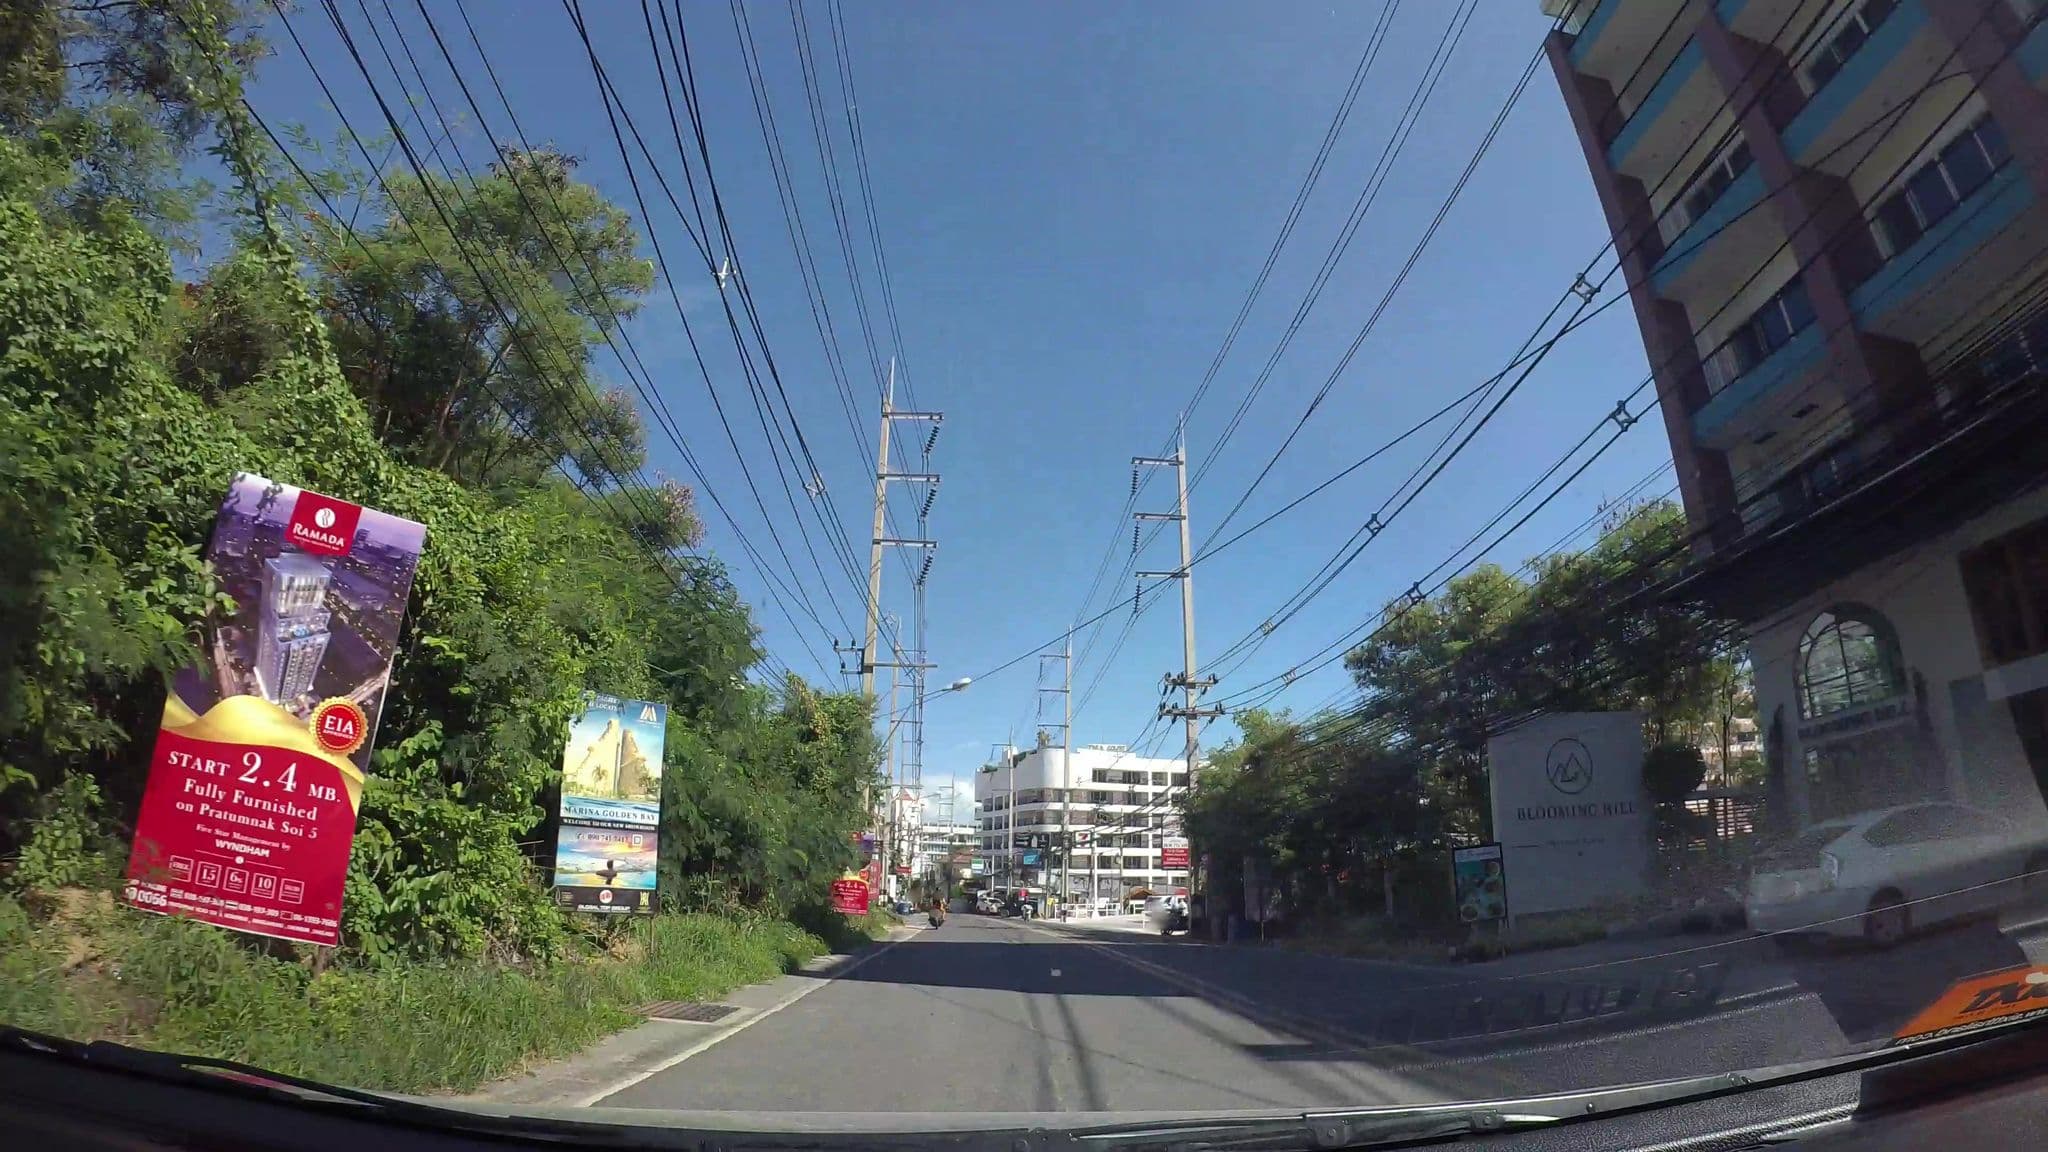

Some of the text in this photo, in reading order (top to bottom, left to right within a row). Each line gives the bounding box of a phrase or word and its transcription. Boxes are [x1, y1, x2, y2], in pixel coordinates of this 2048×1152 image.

[292, 522, 344, 547] RAMADA
[324, 714, 355, 735] EIA
[168, 751, 342, 803] START 2.4 MB.
[184, 778, 318, 821] Fully Furnished
[1517, 800, 1637, 820] BLOOMING HILL
[176, 800, 318, 840] on Pratumnak Soi 5
[563, 806, 656, 821] MARINA GOLDEN BAY
[215, 838, 270, 857] WYNDHAM
[258, 877, 272, 890] 10
